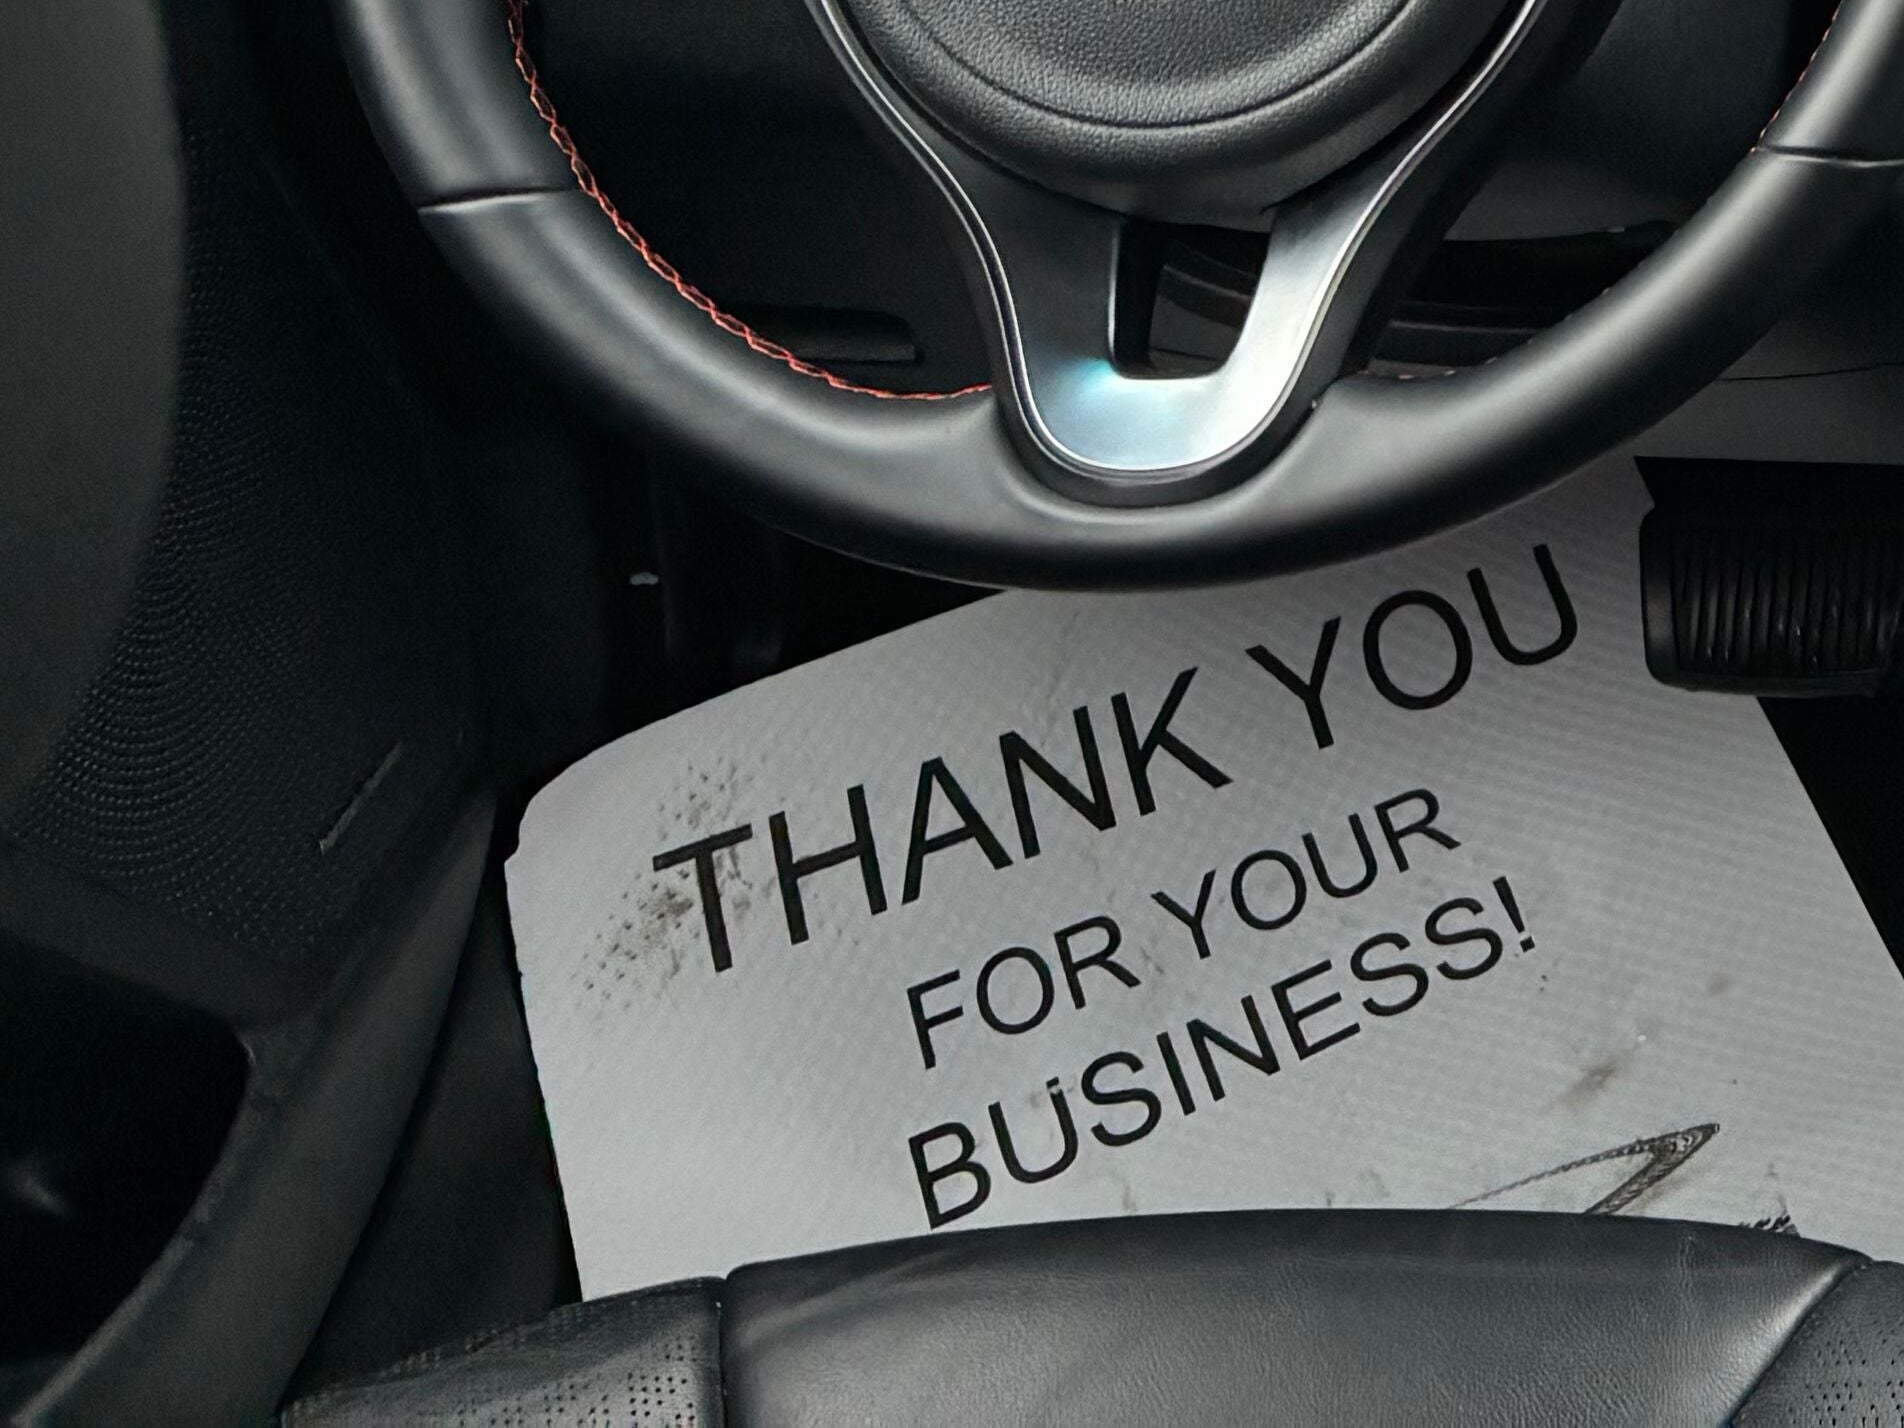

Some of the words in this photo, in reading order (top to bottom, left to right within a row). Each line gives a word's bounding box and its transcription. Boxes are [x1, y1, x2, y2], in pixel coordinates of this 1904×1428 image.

[653, 665, 1234, 974] THANK
[1245, 544, 1578, 749] YOU
[906, 915, 1142, 1069] FOR
[1152, 787, 1461, 960] YOUR
[907, 875, 1536, 1230] BUSINESS!
